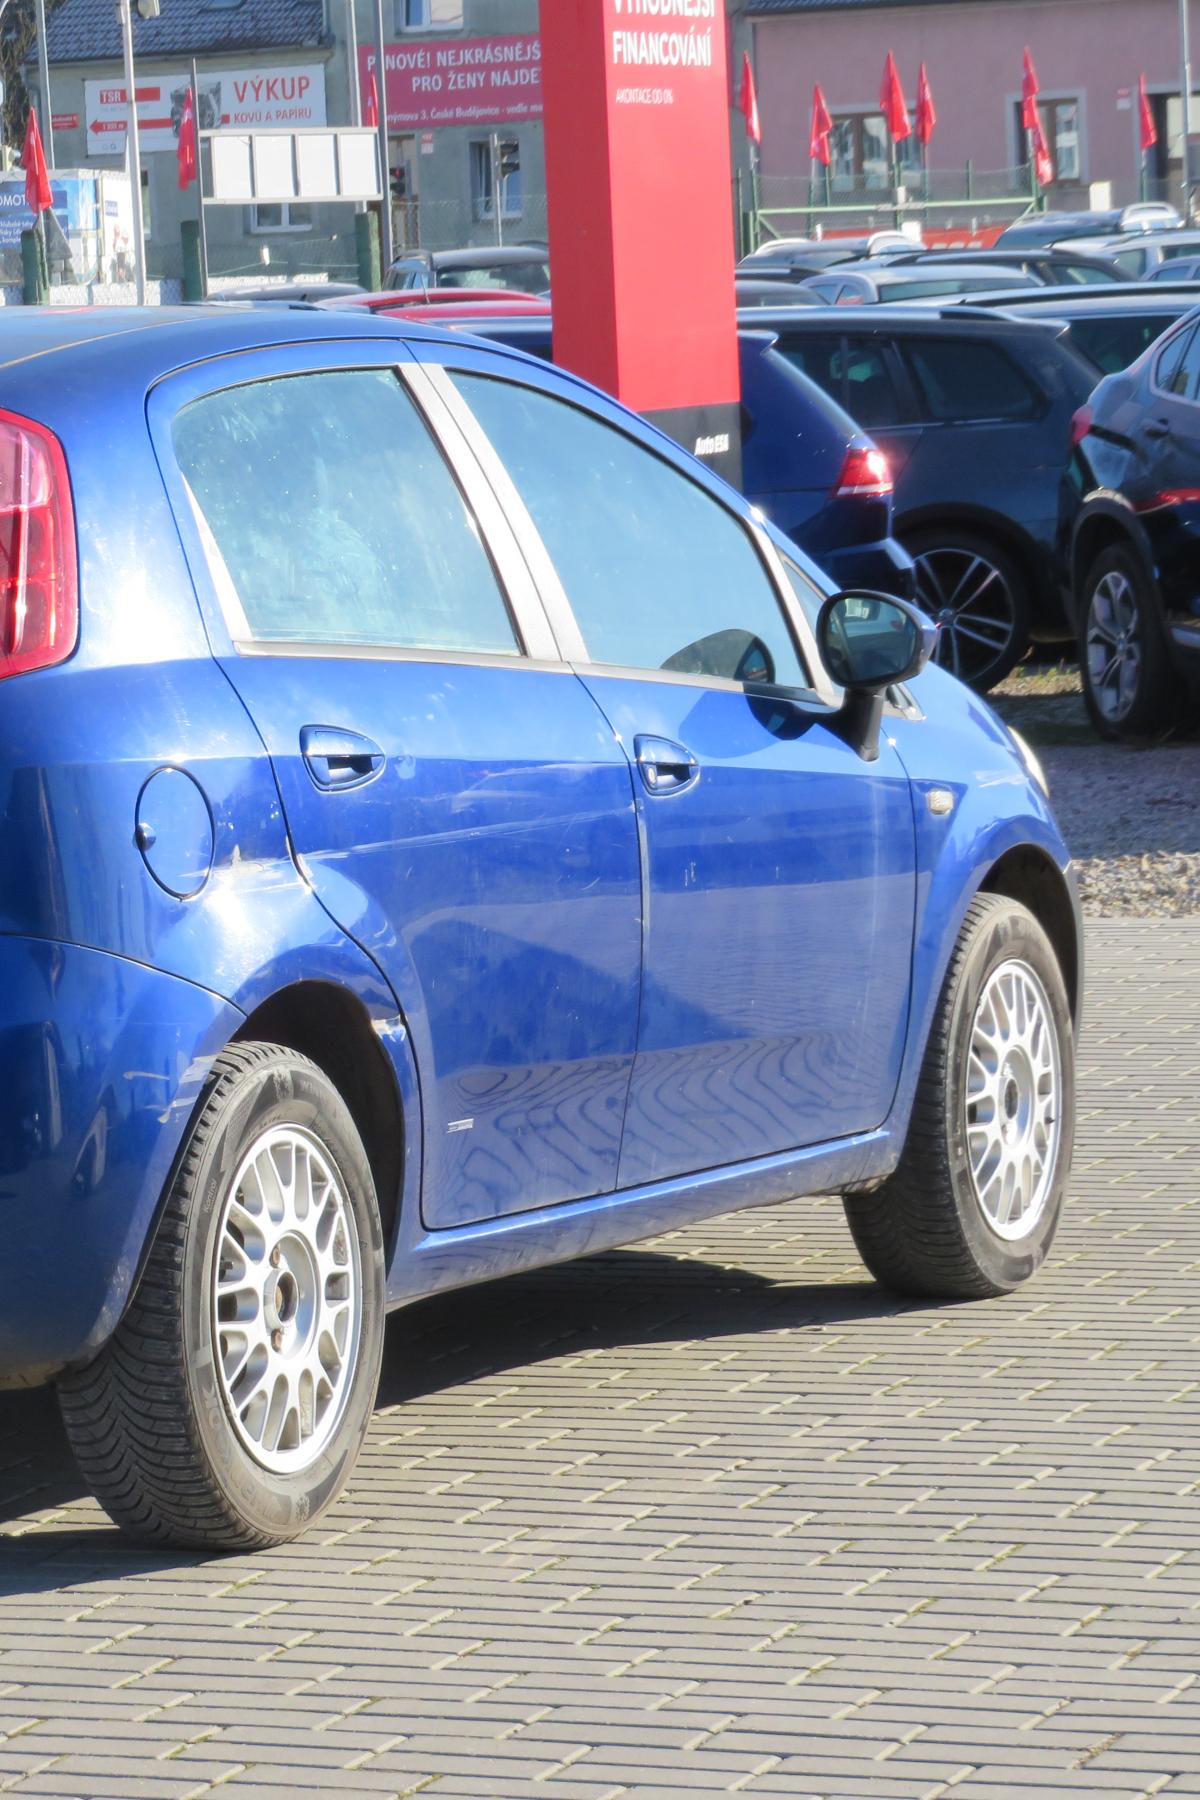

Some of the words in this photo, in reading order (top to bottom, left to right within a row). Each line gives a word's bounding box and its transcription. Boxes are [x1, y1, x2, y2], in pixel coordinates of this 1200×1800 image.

[367, 48, 431, 72] PNOVÉ!
[436, 40, 542, 67] NEJKRÁSNĚJŠ
[613, 25, 712, 66] FINANCOVÁNÍ
[233, 75, 310, 103] VÝKUP
[412, 75, 442, 93] PRO
[448, 70, 486, 90] ŽENY
[491, 67, 540, 85] NAJDE
[102, 90, 121, 104] TSR
[265, 111, 273, 121] A
[276, 106, 312, 120] PAPÍRU
